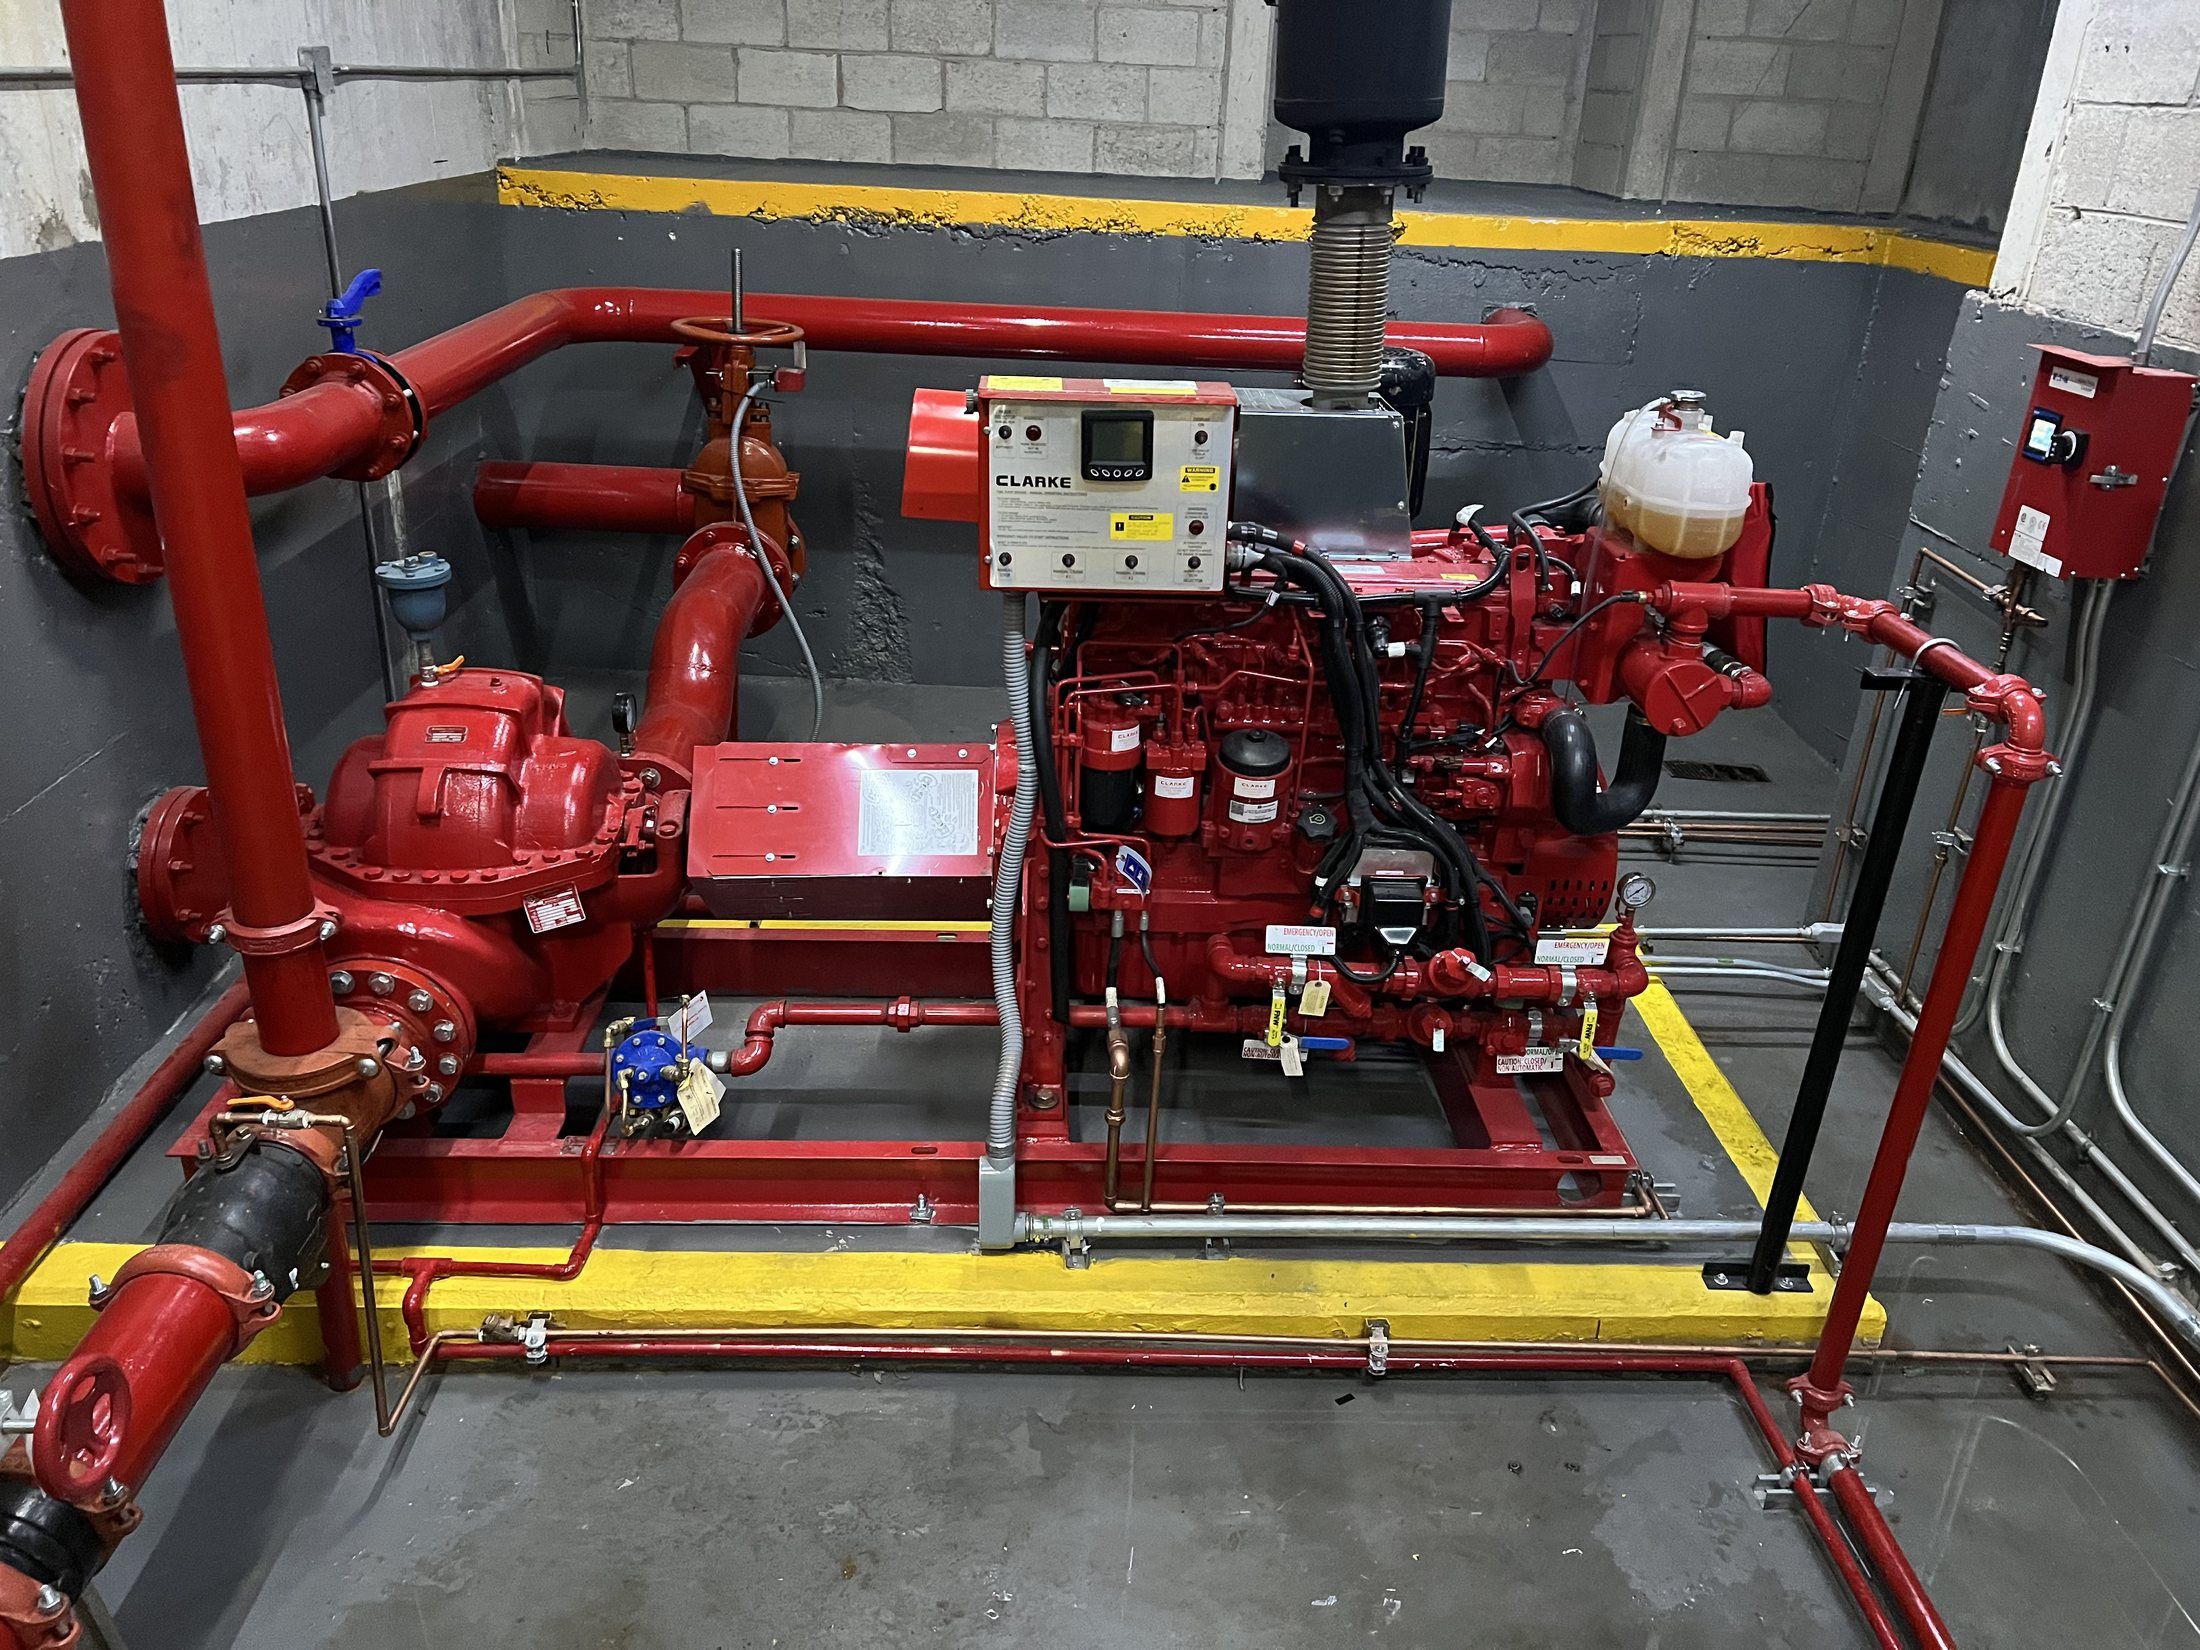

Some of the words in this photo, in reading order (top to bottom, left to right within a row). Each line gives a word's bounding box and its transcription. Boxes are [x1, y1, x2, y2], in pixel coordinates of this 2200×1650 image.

[995, 475, 1072, 489] CLARKE
[1118, 731, 1138, 739] CLARKE
[1284, 928, 1334, 937] EMERGENCY/OPEN
[1267, 943, 1316, 952] NORMAL/CLOSED
[1536, 955, 1585, 963] NORMAL/CLOSED
